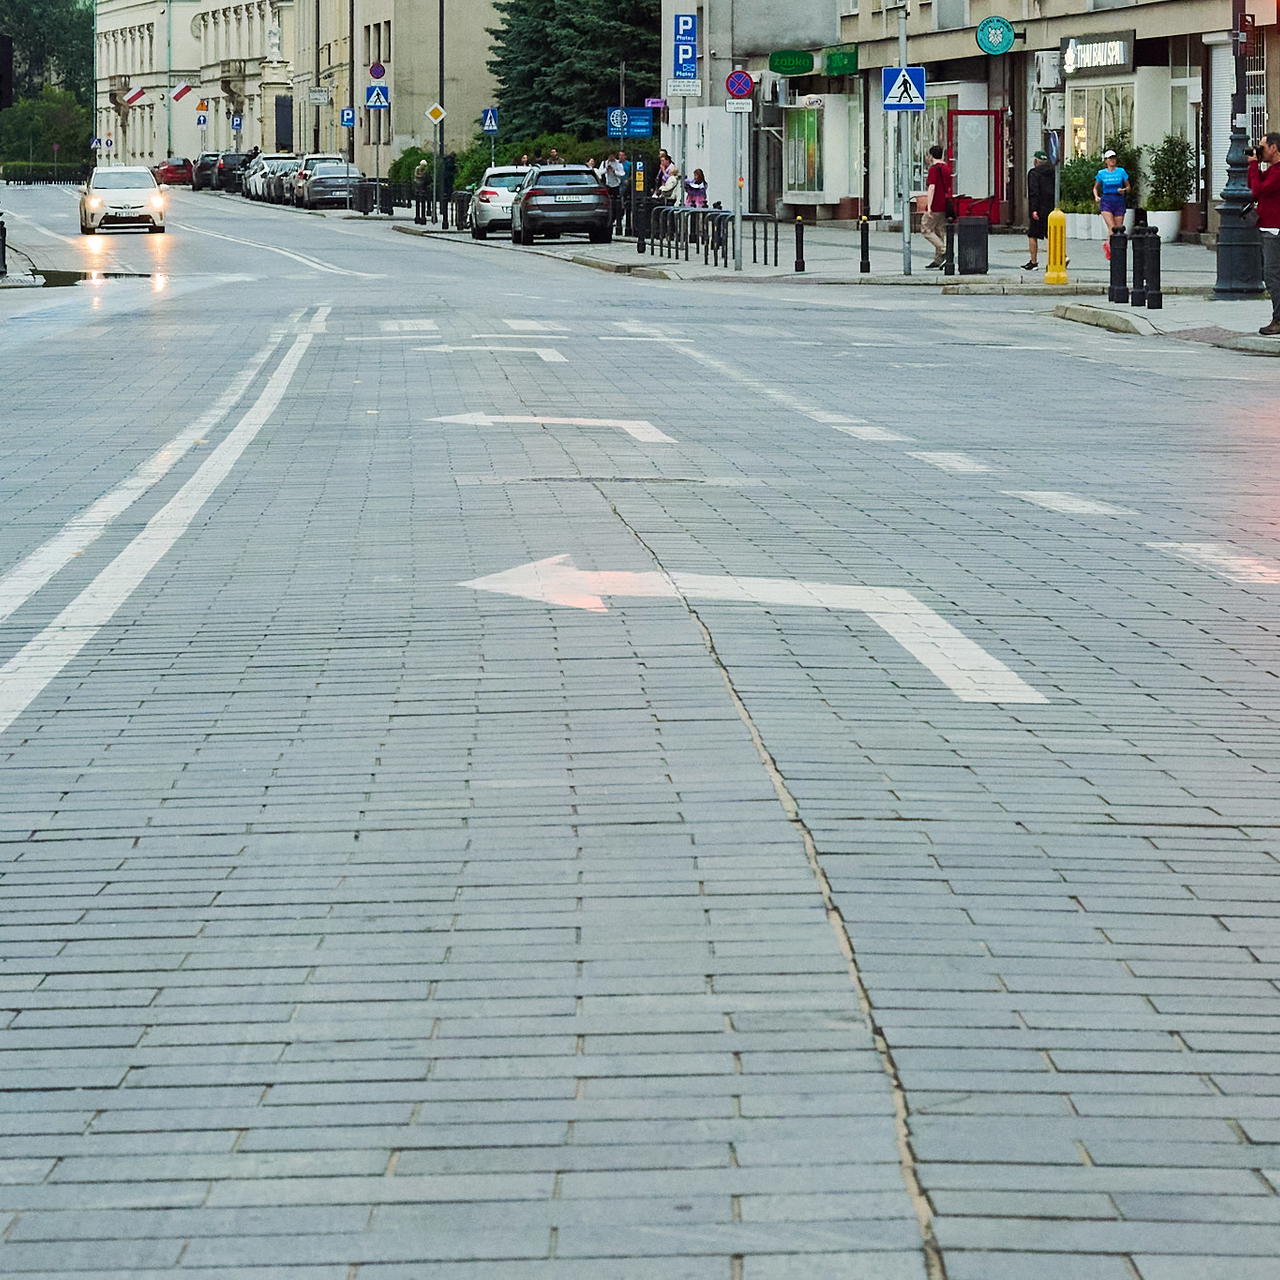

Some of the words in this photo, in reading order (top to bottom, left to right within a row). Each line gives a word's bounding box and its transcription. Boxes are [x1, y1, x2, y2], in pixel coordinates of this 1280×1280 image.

[679, 16, 693, 35] P
[679, 45, 693, 64] P
[1077, 44, 1092, 68] THAI
[1092, 42, 1107, 66] BALI
[1107, 40, 1122, 65] SPA
[234, 117, 240, 126] P
[344, 110, 353, 122] P
